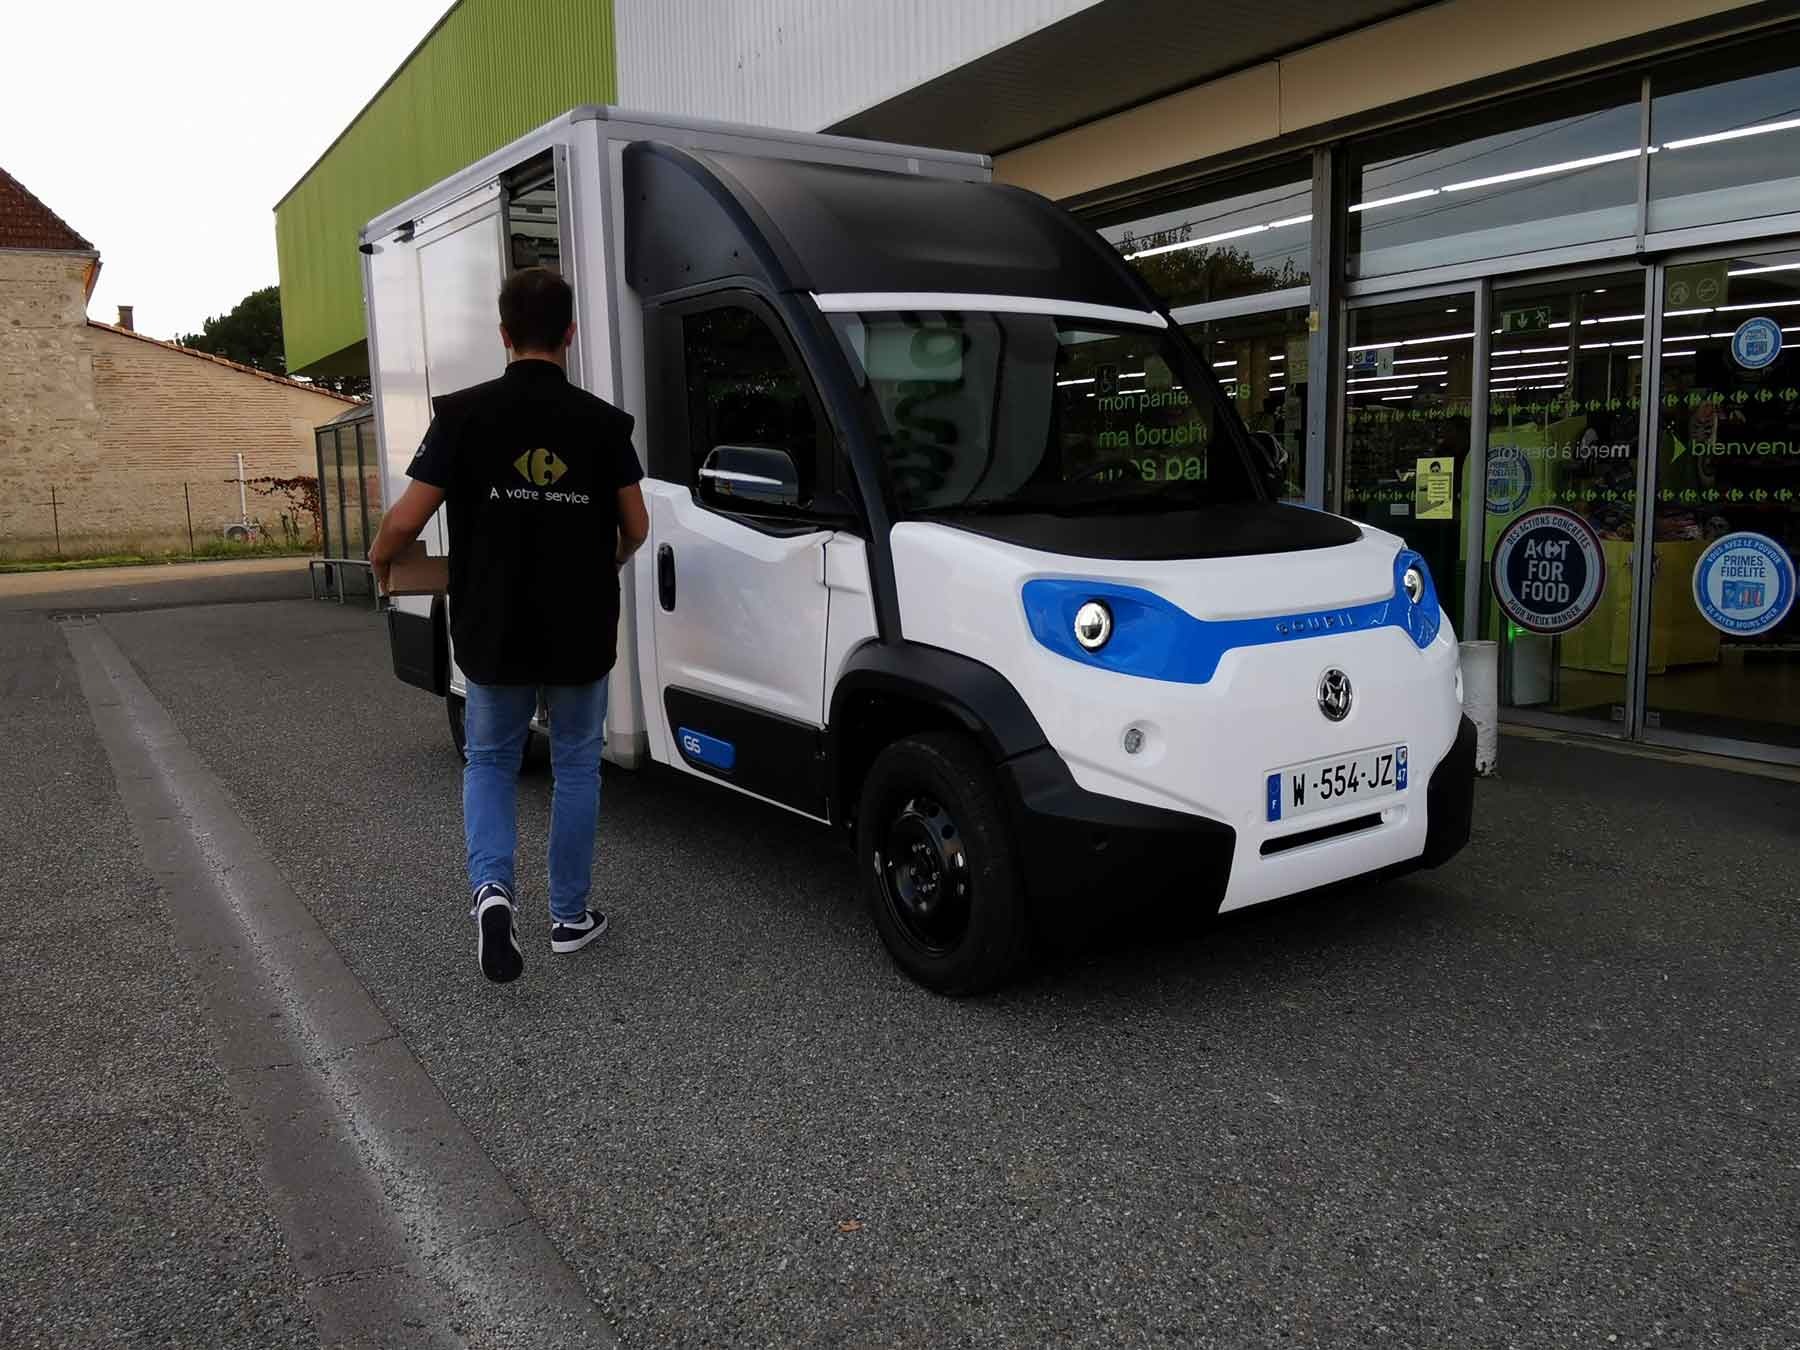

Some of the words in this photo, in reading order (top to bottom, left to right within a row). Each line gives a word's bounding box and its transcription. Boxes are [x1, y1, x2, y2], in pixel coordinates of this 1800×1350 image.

[1139, 389, 1192, 412] panie
[1097, 431, 1129, 448] ma
[506, 488, 539, 500] votre
[545, 491, 590, 504] service
[1519, 515, 1551, 531] ACTIONS
[1724, 555, 1763, 567] PRIMES
[1527, 560, 1564, 581] FOR
[1521, 581, 1570, 603] FOOD
[1551, 605, 1581, 625] MANGER
